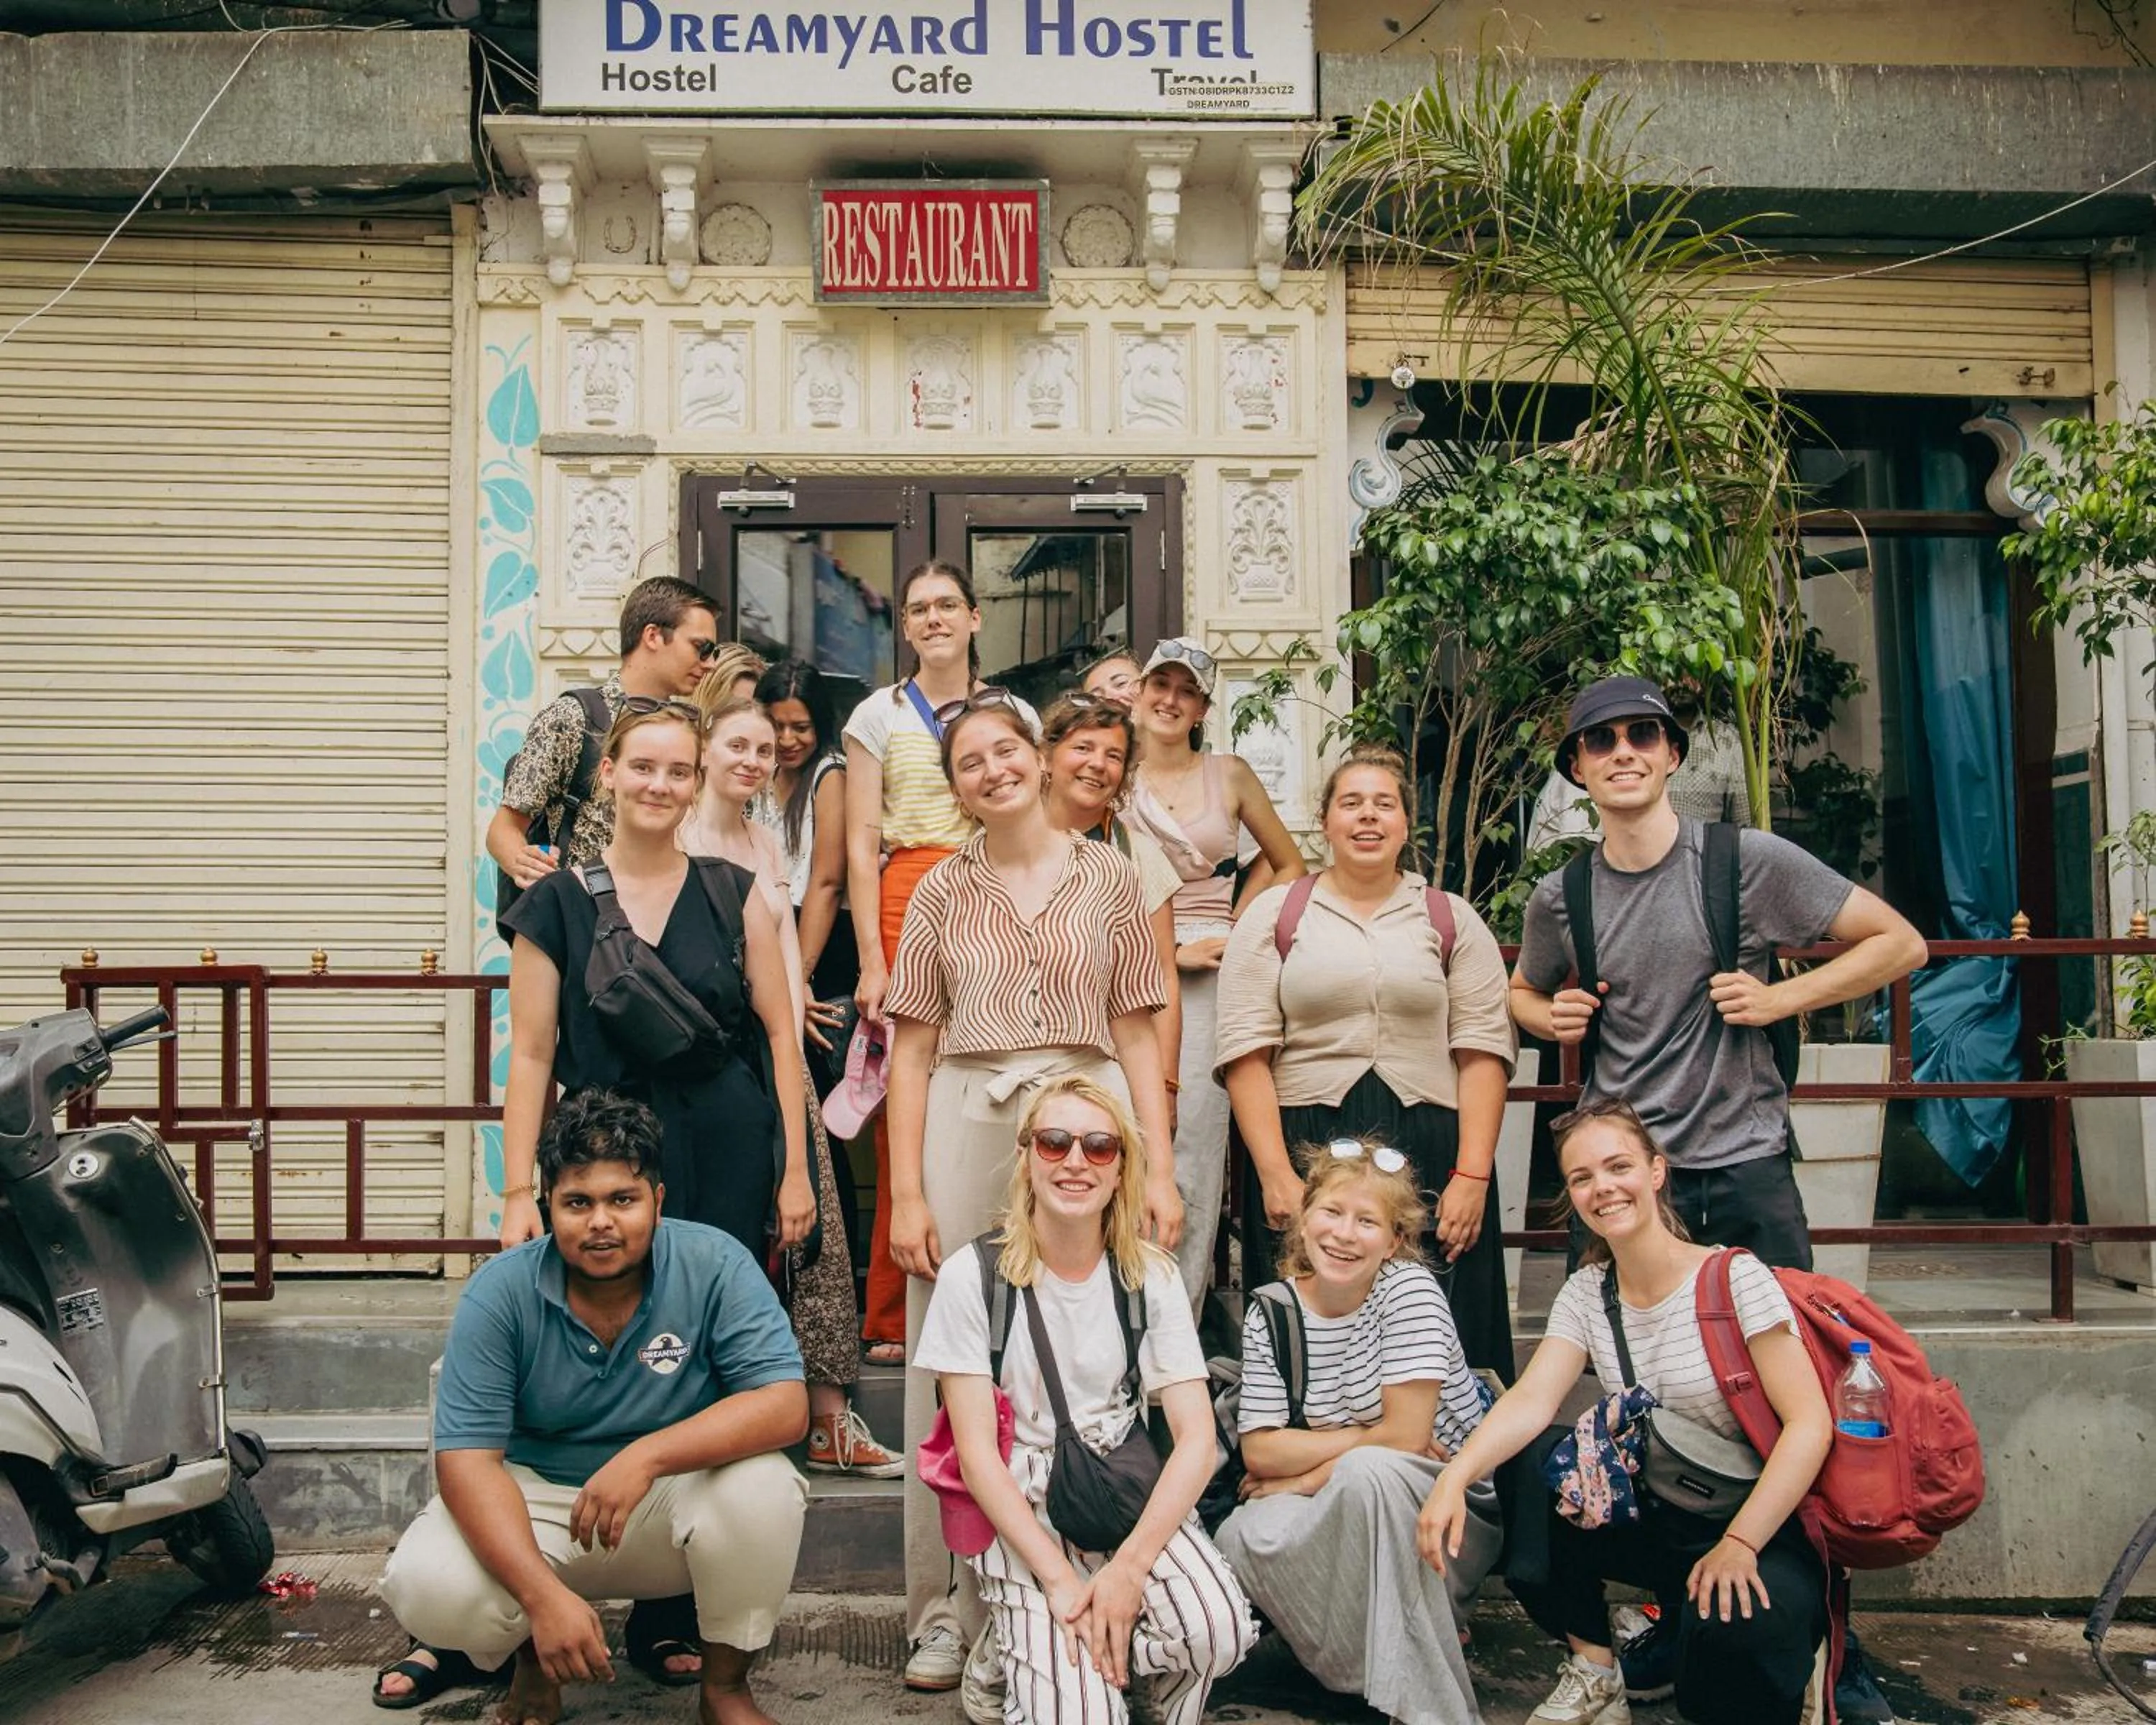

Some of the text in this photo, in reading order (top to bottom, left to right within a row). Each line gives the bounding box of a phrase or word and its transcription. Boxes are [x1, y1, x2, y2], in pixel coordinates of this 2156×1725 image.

[602, 63, 717, 92] Hostel
[892, 65, 972, 93] Cafe
[1187, 100, 1250, 109] DREAMYARD
[822, 201, 1033, 288] RESTAURANT
